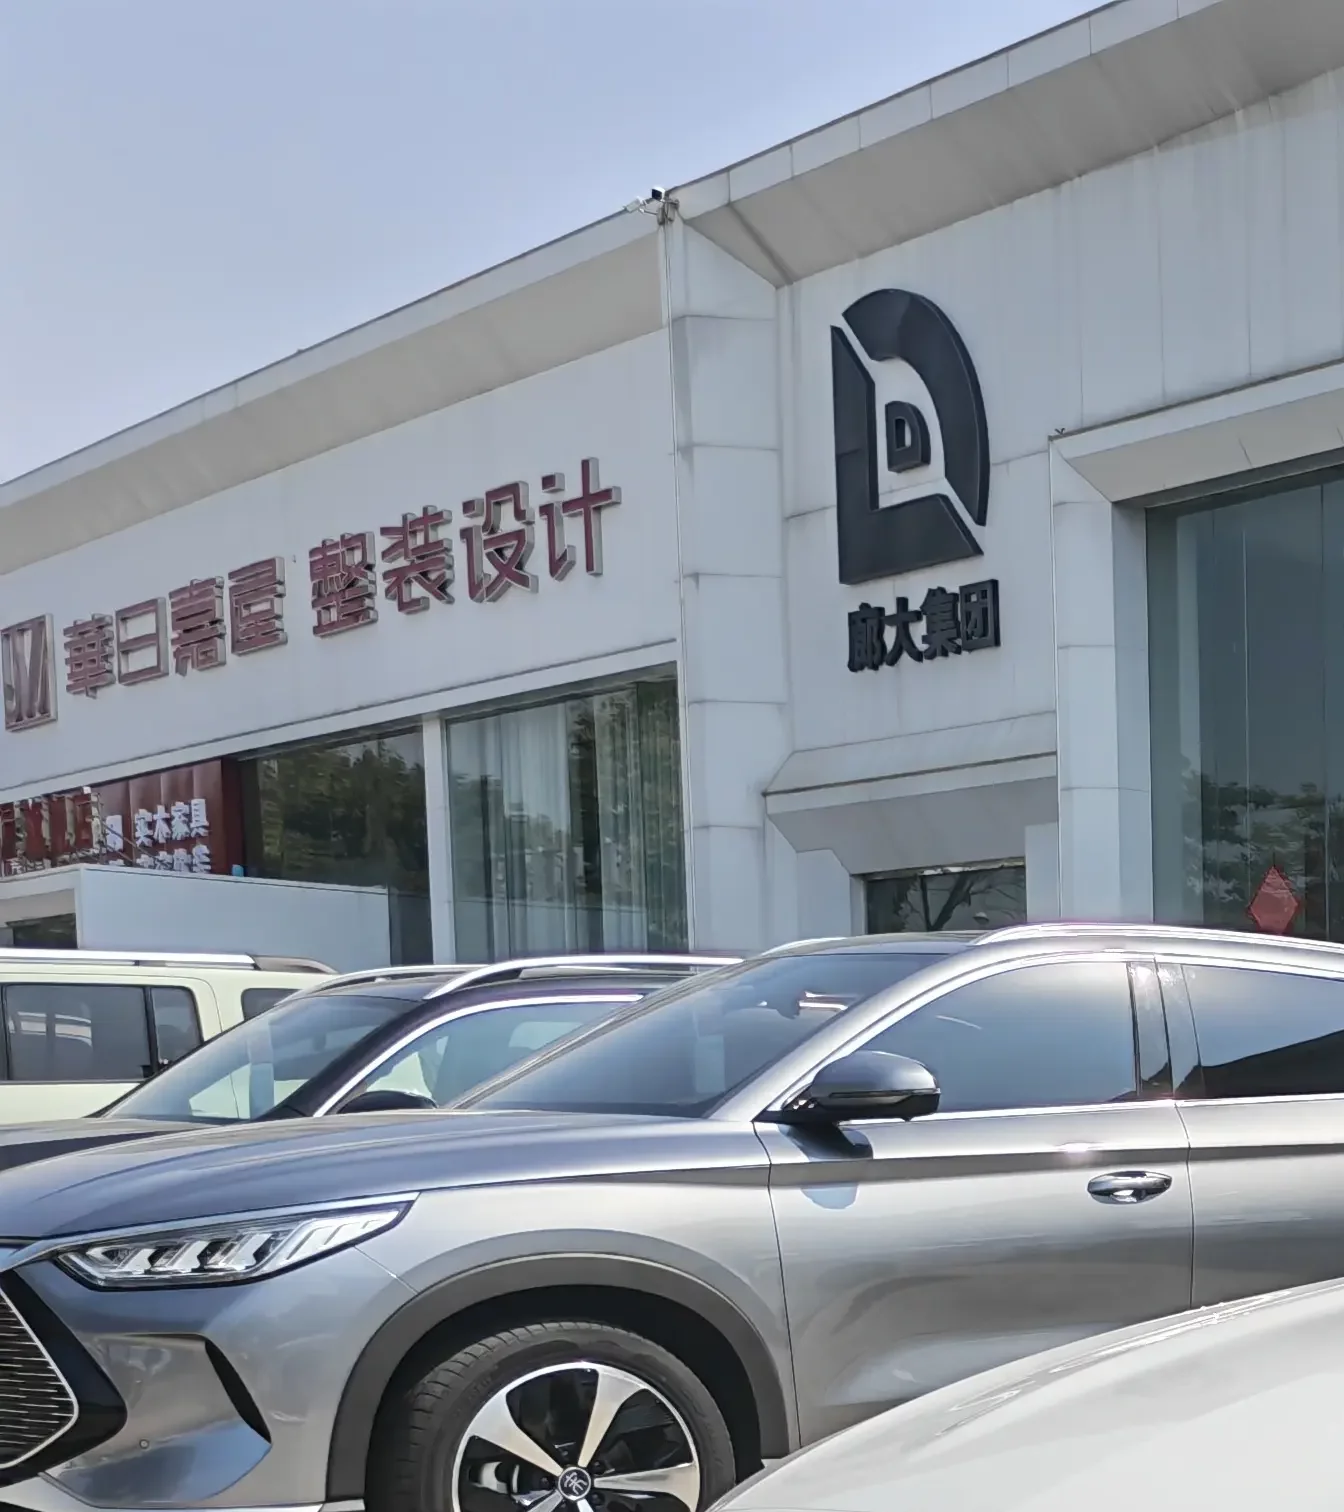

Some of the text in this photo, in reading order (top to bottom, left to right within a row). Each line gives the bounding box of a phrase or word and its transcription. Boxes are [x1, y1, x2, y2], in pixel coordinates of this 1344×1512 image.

[309, 457, 622, 637] 整装设计
[847, 578, 1001, 672] 廊大集团
